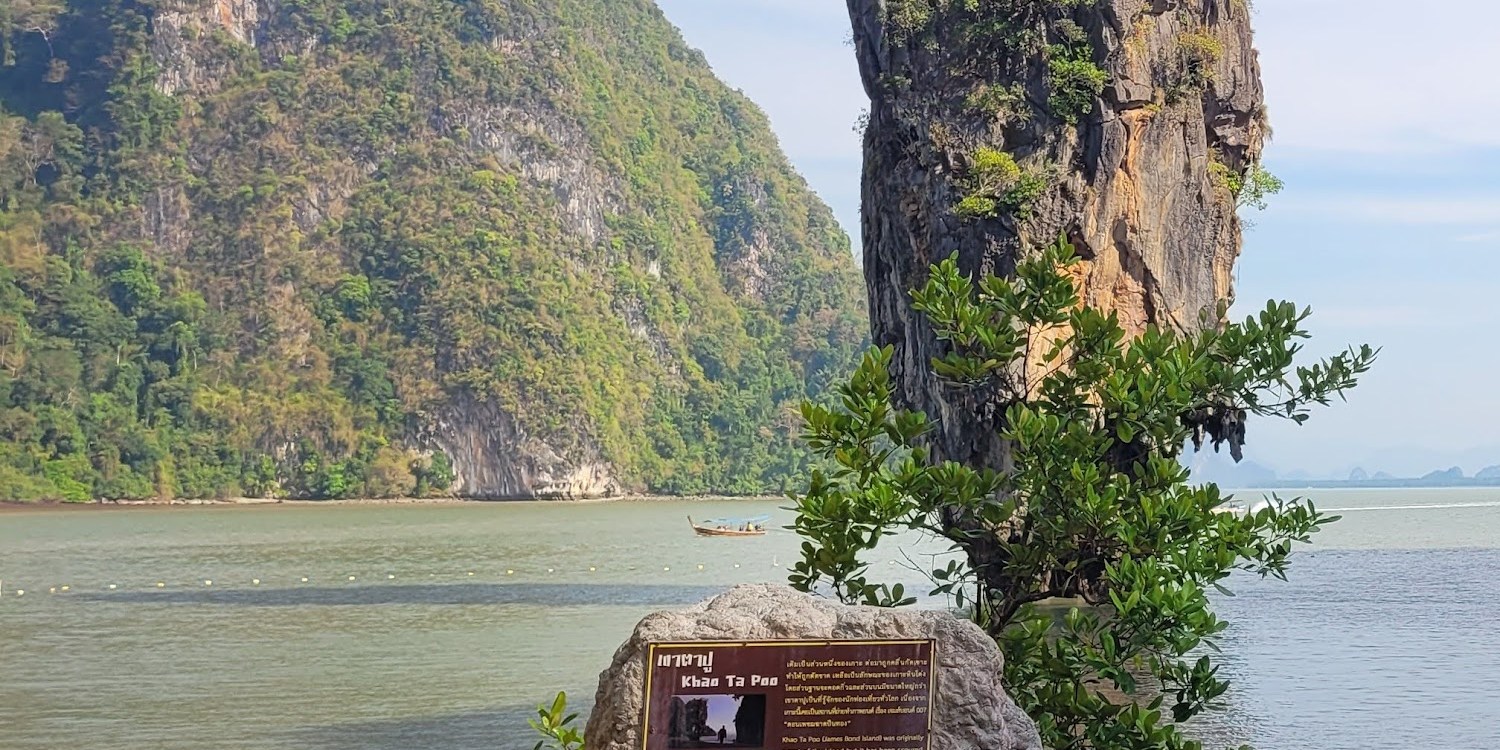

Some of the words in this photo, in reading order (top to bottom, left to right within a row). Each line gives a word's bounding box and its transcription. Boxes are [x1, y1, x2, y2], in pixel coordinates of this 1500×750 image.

[657, 651, 713, 673] เขาตาปู
[681, 675, 719, 688] Khao
[726, 675, 745, 687] Ta
[751, 675, 778, 687] Poo
